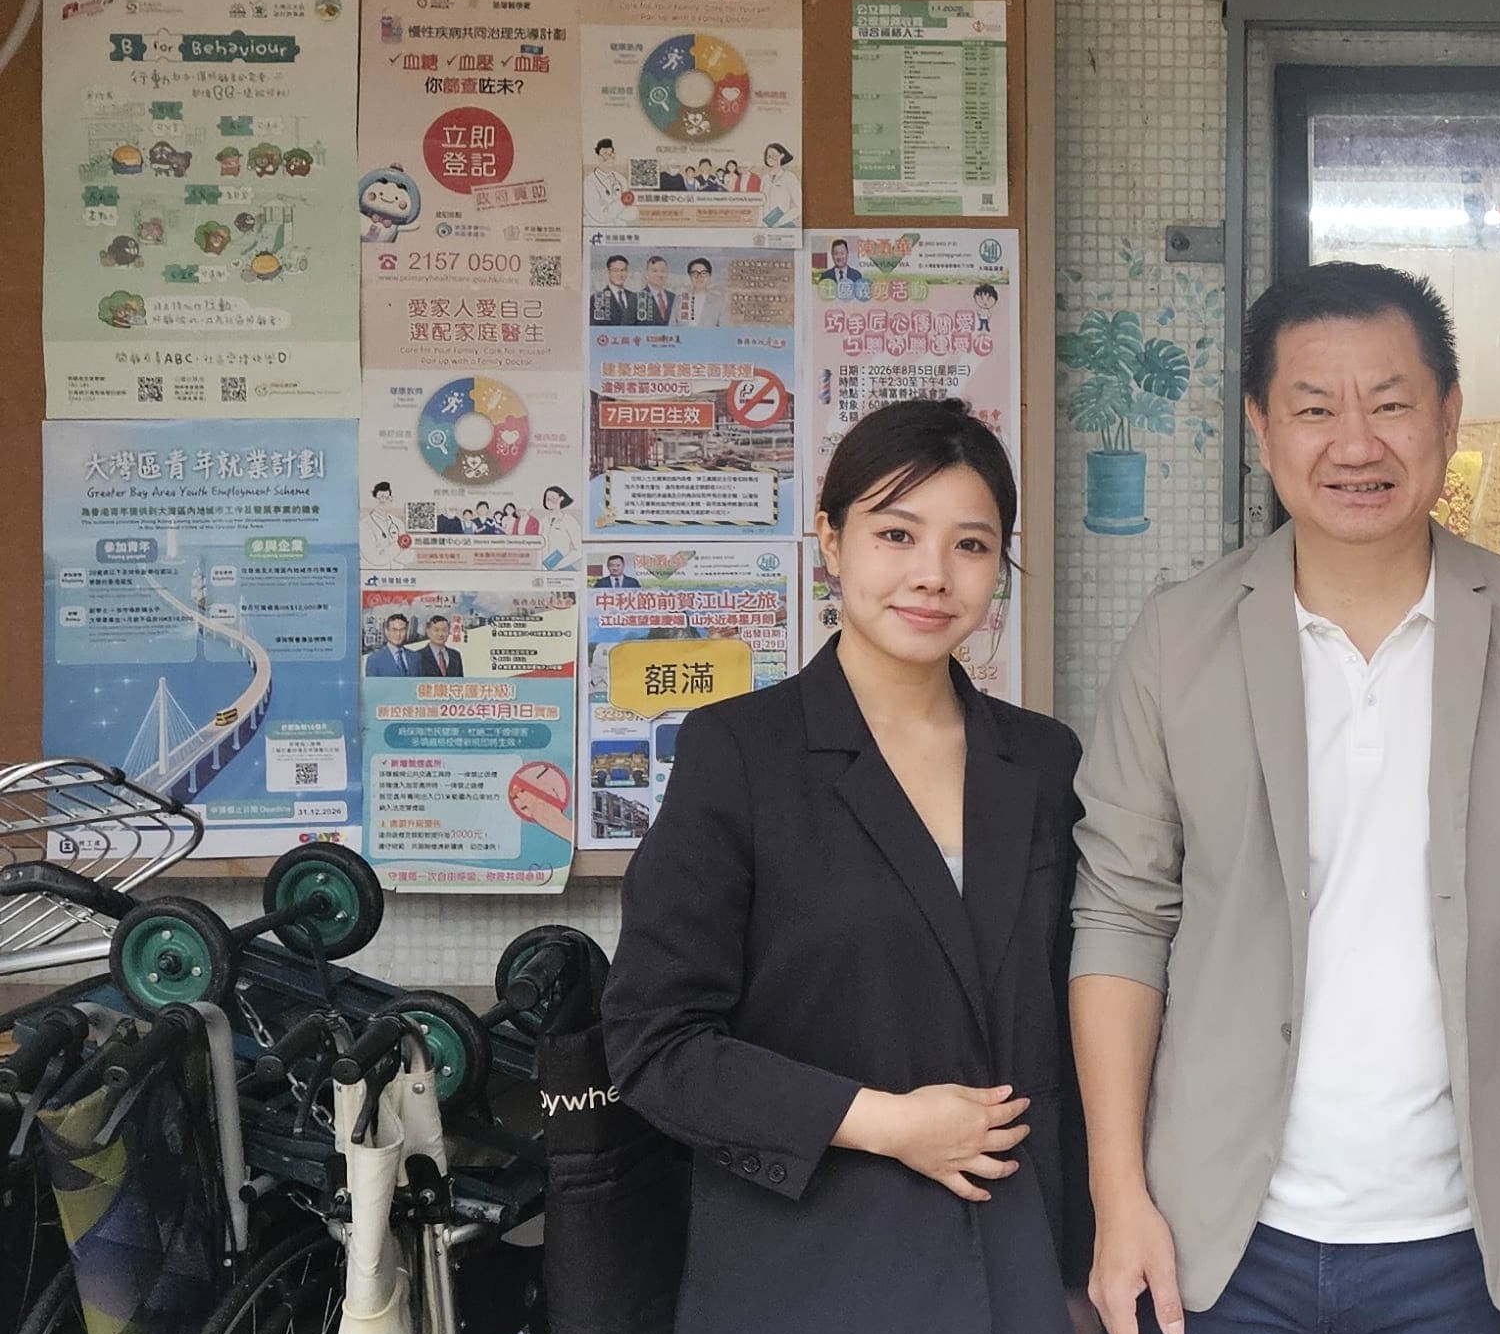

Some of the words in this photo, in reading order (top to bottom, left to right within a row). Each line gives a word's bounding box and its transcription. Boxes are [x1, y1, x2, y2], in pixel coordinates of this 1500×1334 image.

[408, 26, 567, 42] 慢性疾病共同治理先導計劃
[121, 38, 133, 55] B
[153, 41, 174, 53] for
[191, 40, 288, 57] Behaviour
[441, 125, 496, 150] 立即
[442, 151, 497, 178] 登記
[408, 251, 460, 271] 2157
[467, 253, 522, 272] 0500
[408, 298, 544, 318] 愛家人愛自己
[409, 322, 545, 343] 選配家庭醫生
[606, 406, 701, 425] 7月17日生效
[84, 448, 328, 482] 大灣區青年就業計劃
[87, 486, 126, 499] Greater
[129, 486, 148, 499] Bay
[152, 486, 176, 498] Area
[179, 486, 208, 498] Youth
[273, 485, 311, 497] Scheme
[595, 592, 777, 611] 中秋節前賀江山之旅
[644, 662, 715, 696] 額滿
